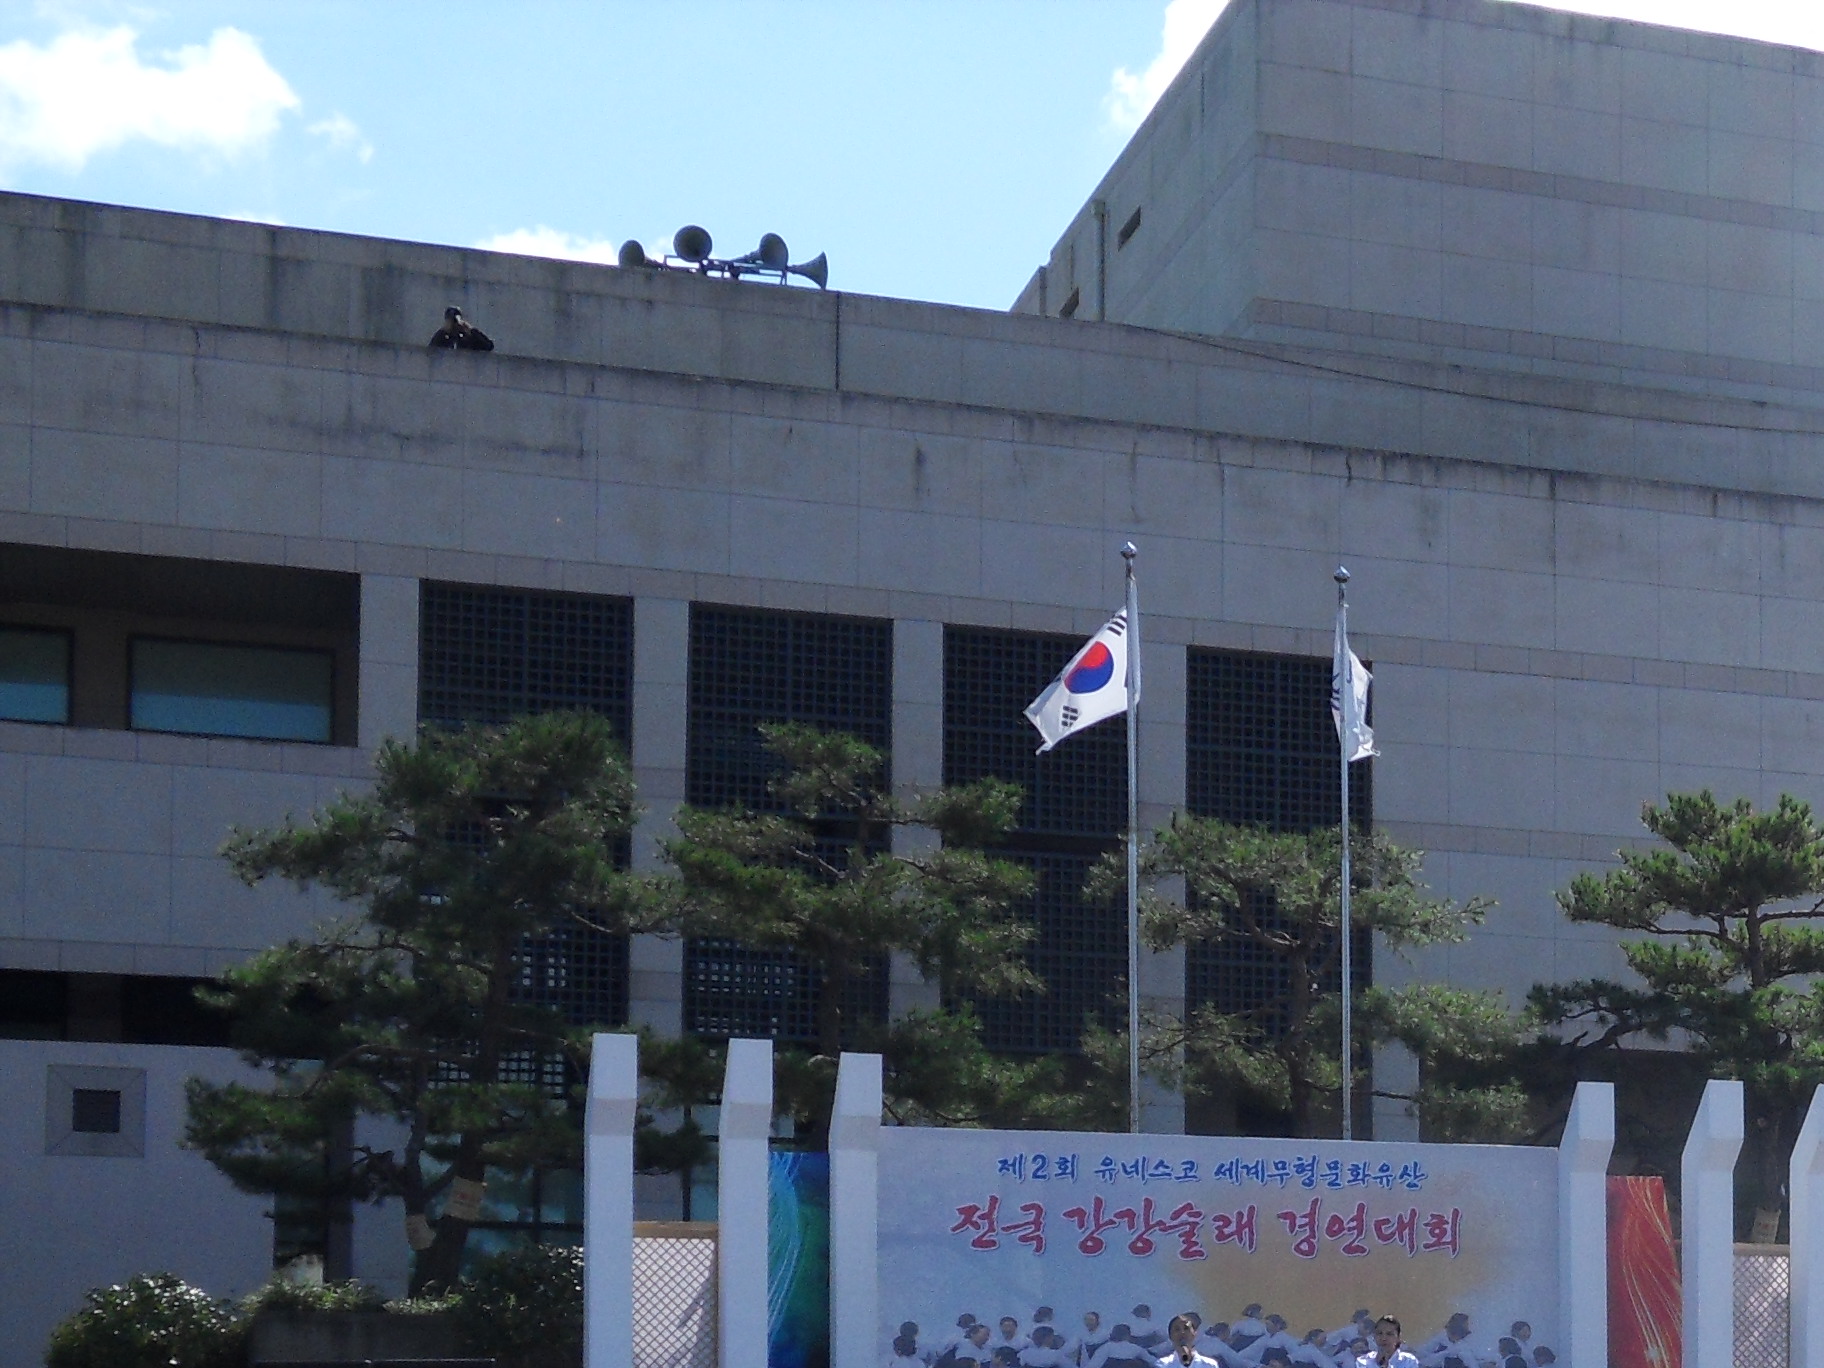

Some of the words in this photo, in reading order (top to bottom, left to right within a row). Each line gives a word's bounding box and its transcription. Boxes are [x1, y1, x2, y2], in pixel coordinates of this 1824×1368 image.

[997, 1154, 1078, 1182] 제2회
[1094, 1154, 1199, 1183] 유네스코
[1213, 1155, 1427, 1189] 세계무형문화유산
[951, 1194, 1048, 1254] 전국
[1061, 1196, 1259, 1260] 강강술래
[1275, 1196, 1463, 1259] 경연대회
